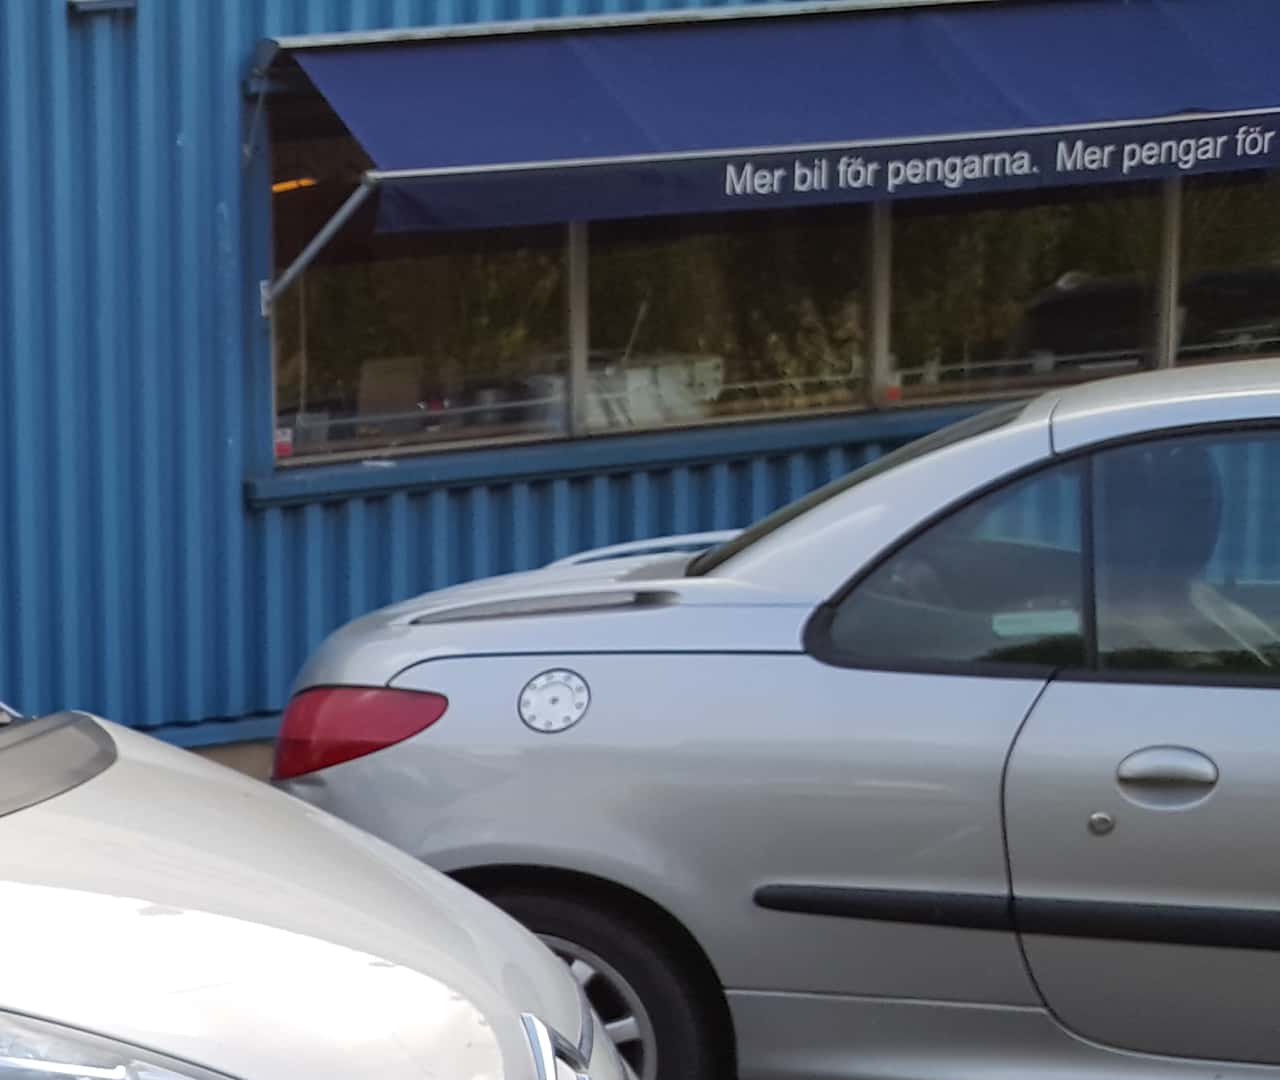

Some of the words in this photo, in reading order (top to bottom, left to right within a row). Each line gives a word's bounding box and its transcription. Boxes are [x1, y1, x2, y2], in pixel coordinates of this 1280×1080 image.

[725, 162, 787, 196] Mer
[794, 158, 829, 192] bil
[837, 155, 881, 189] för
[887, 150, 1040, 193] pengarna.
[1055, 139, 1116, 172] Mer
[1122, 134, 1228, 174] pengar
[1235, 125, 1276, 157] för
